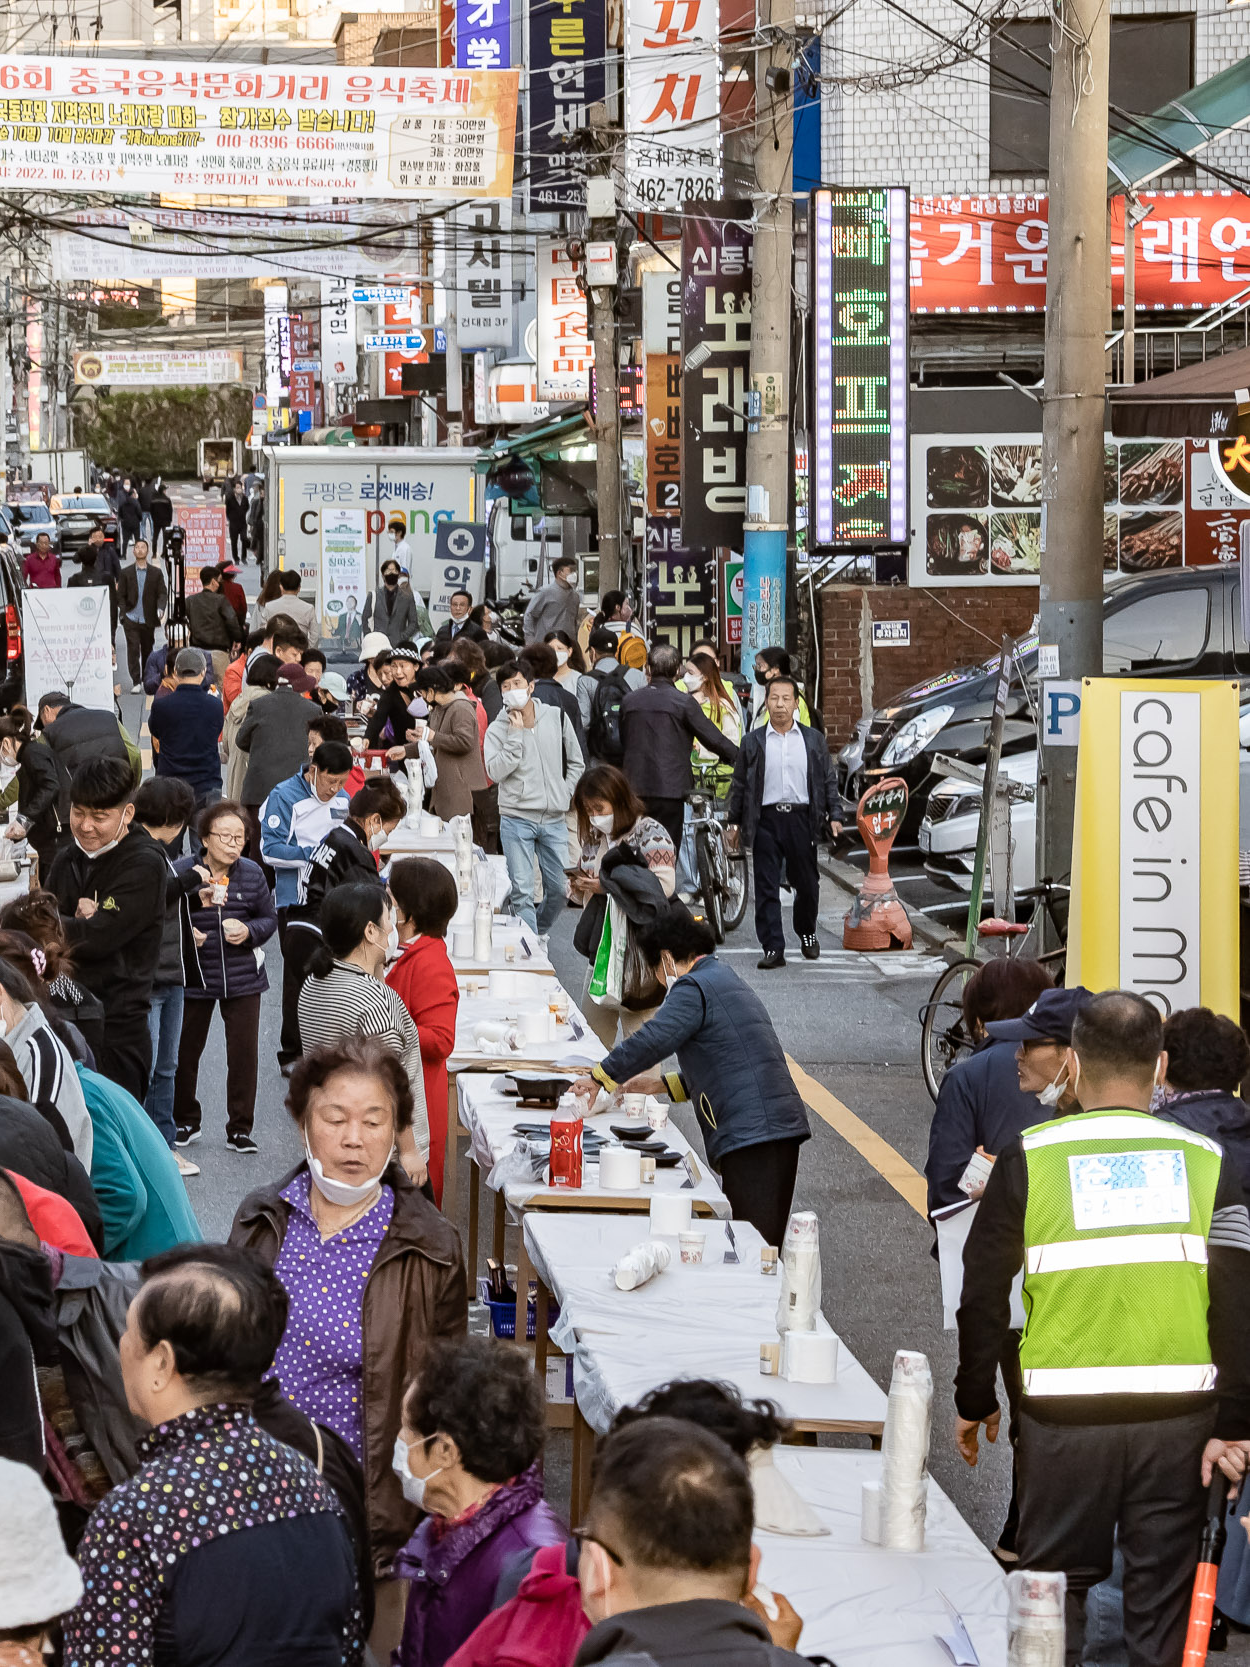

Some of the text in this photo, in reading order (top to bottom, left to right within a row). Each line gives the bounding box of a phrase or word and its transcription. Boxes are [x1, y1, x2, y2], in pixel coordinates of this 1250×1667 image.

[68, 68, 329, 102] 중국음식문화거리
[344, 76, 471, 104] 음식축제
[51, 101, 104, 125] 지역주민
[109, 103, 164, 129] 노래자랑
[220, 107, 292, 131] 참가접수
[298, 109, 375, 133] 받습니다!
[216, 133, 334, 151] 010-8396-6666
[635, 177, 715, 202] 462-7826
[466, 203, 501, 309] 고시텔
[495, 317, 509, 328] 3F
[302, 481, 433, 502] 쿠팡은 로켓배송!
[876, 628, 908, 639] 주차금지
[1047, 692, 1082, 735] P
[1133, 699, 1188, 833] cafe
[1133, 858, 1187, 902] in
[1082, 1193, 1180, 1216] PATROL
